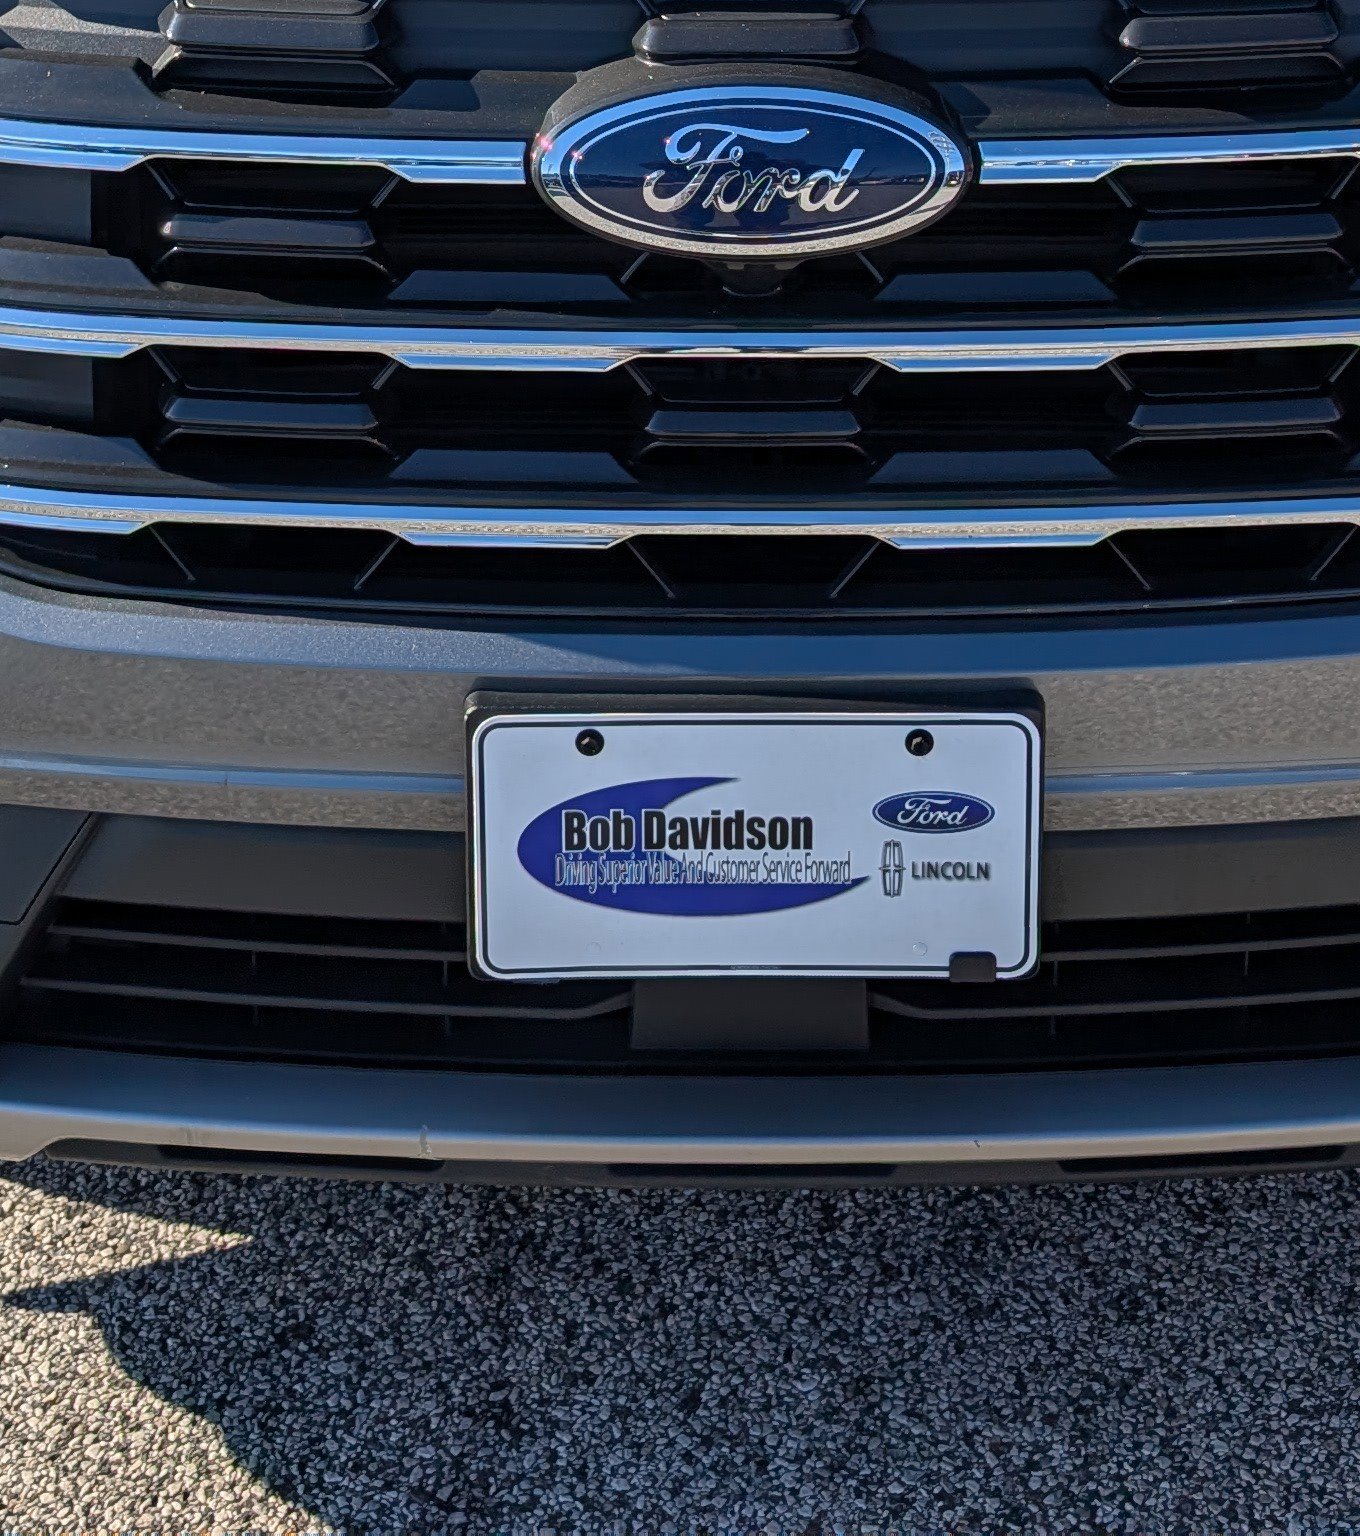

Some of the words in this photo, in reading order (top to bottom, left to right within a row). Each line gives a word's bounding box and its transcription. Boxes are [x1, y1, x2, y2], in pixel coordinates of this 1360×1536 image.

[642, 122, 866, 213] Ford
[562, 809, 635, 852] Bob
[642, 809, 814, 852] Davidson
[897, 797, 969, 825] Ford
[554, 852, 597, 894] Driving
[597, 852, 647, 894] Superior
[647, 851, 678, 885] Value
[680, 852, 703, 884] And
[705, 852, 761, 884] Customer
[761, 851, 803, 883] Service
[803, 850, 852, 884] Forward
[911, 861, 990, 880] LINCOLN
